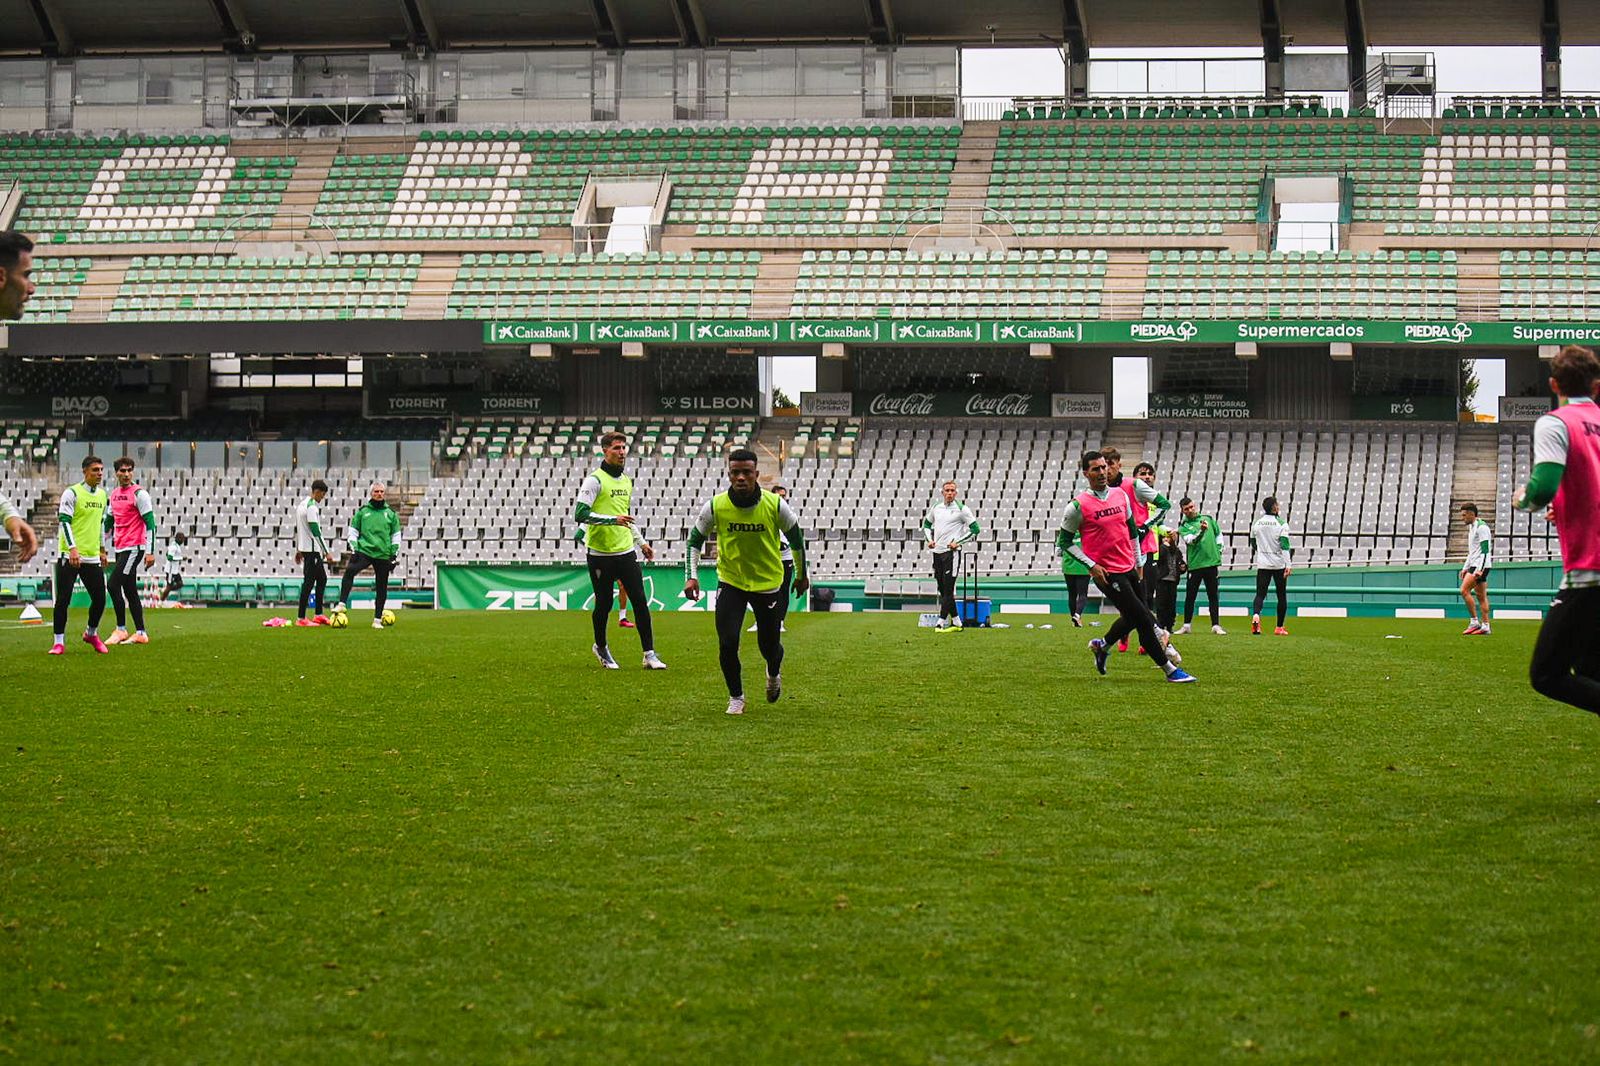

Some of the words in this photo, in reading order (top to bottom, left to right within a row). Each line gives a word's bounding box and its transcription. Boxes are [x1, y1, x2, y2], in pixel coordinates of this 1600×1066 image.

[515, 325, 571, 338] CaixaBank
[614, 325, 670, 338] CaixaBank
[713, 325, 771, 338] CaixaBank
[814, 325, 872, 338] CaixaBank
[916, 325, 973, 338] CaixaBank
[1017, 325, 1075, 338] CaixaBank
[1130, 324, 1176, 337] PIEDRA
[1237, 323, 1364, 340] Supermercados
[1404, 325, 1450, 338] PIEDRA
[388, 398, 448, 409] TORRENT
[481, 398, 541, 409] TORRENT
[679, 396, 754, 409] SILBON
[1149, 409, 1170, 418] SAN
[1172, 409, 1212, 418] RAFAEL
[1213, 409, 1250, 418] MOTOR
[727, 522, 766, 532] Joma
[485, 590, 568, 610] ZEN
